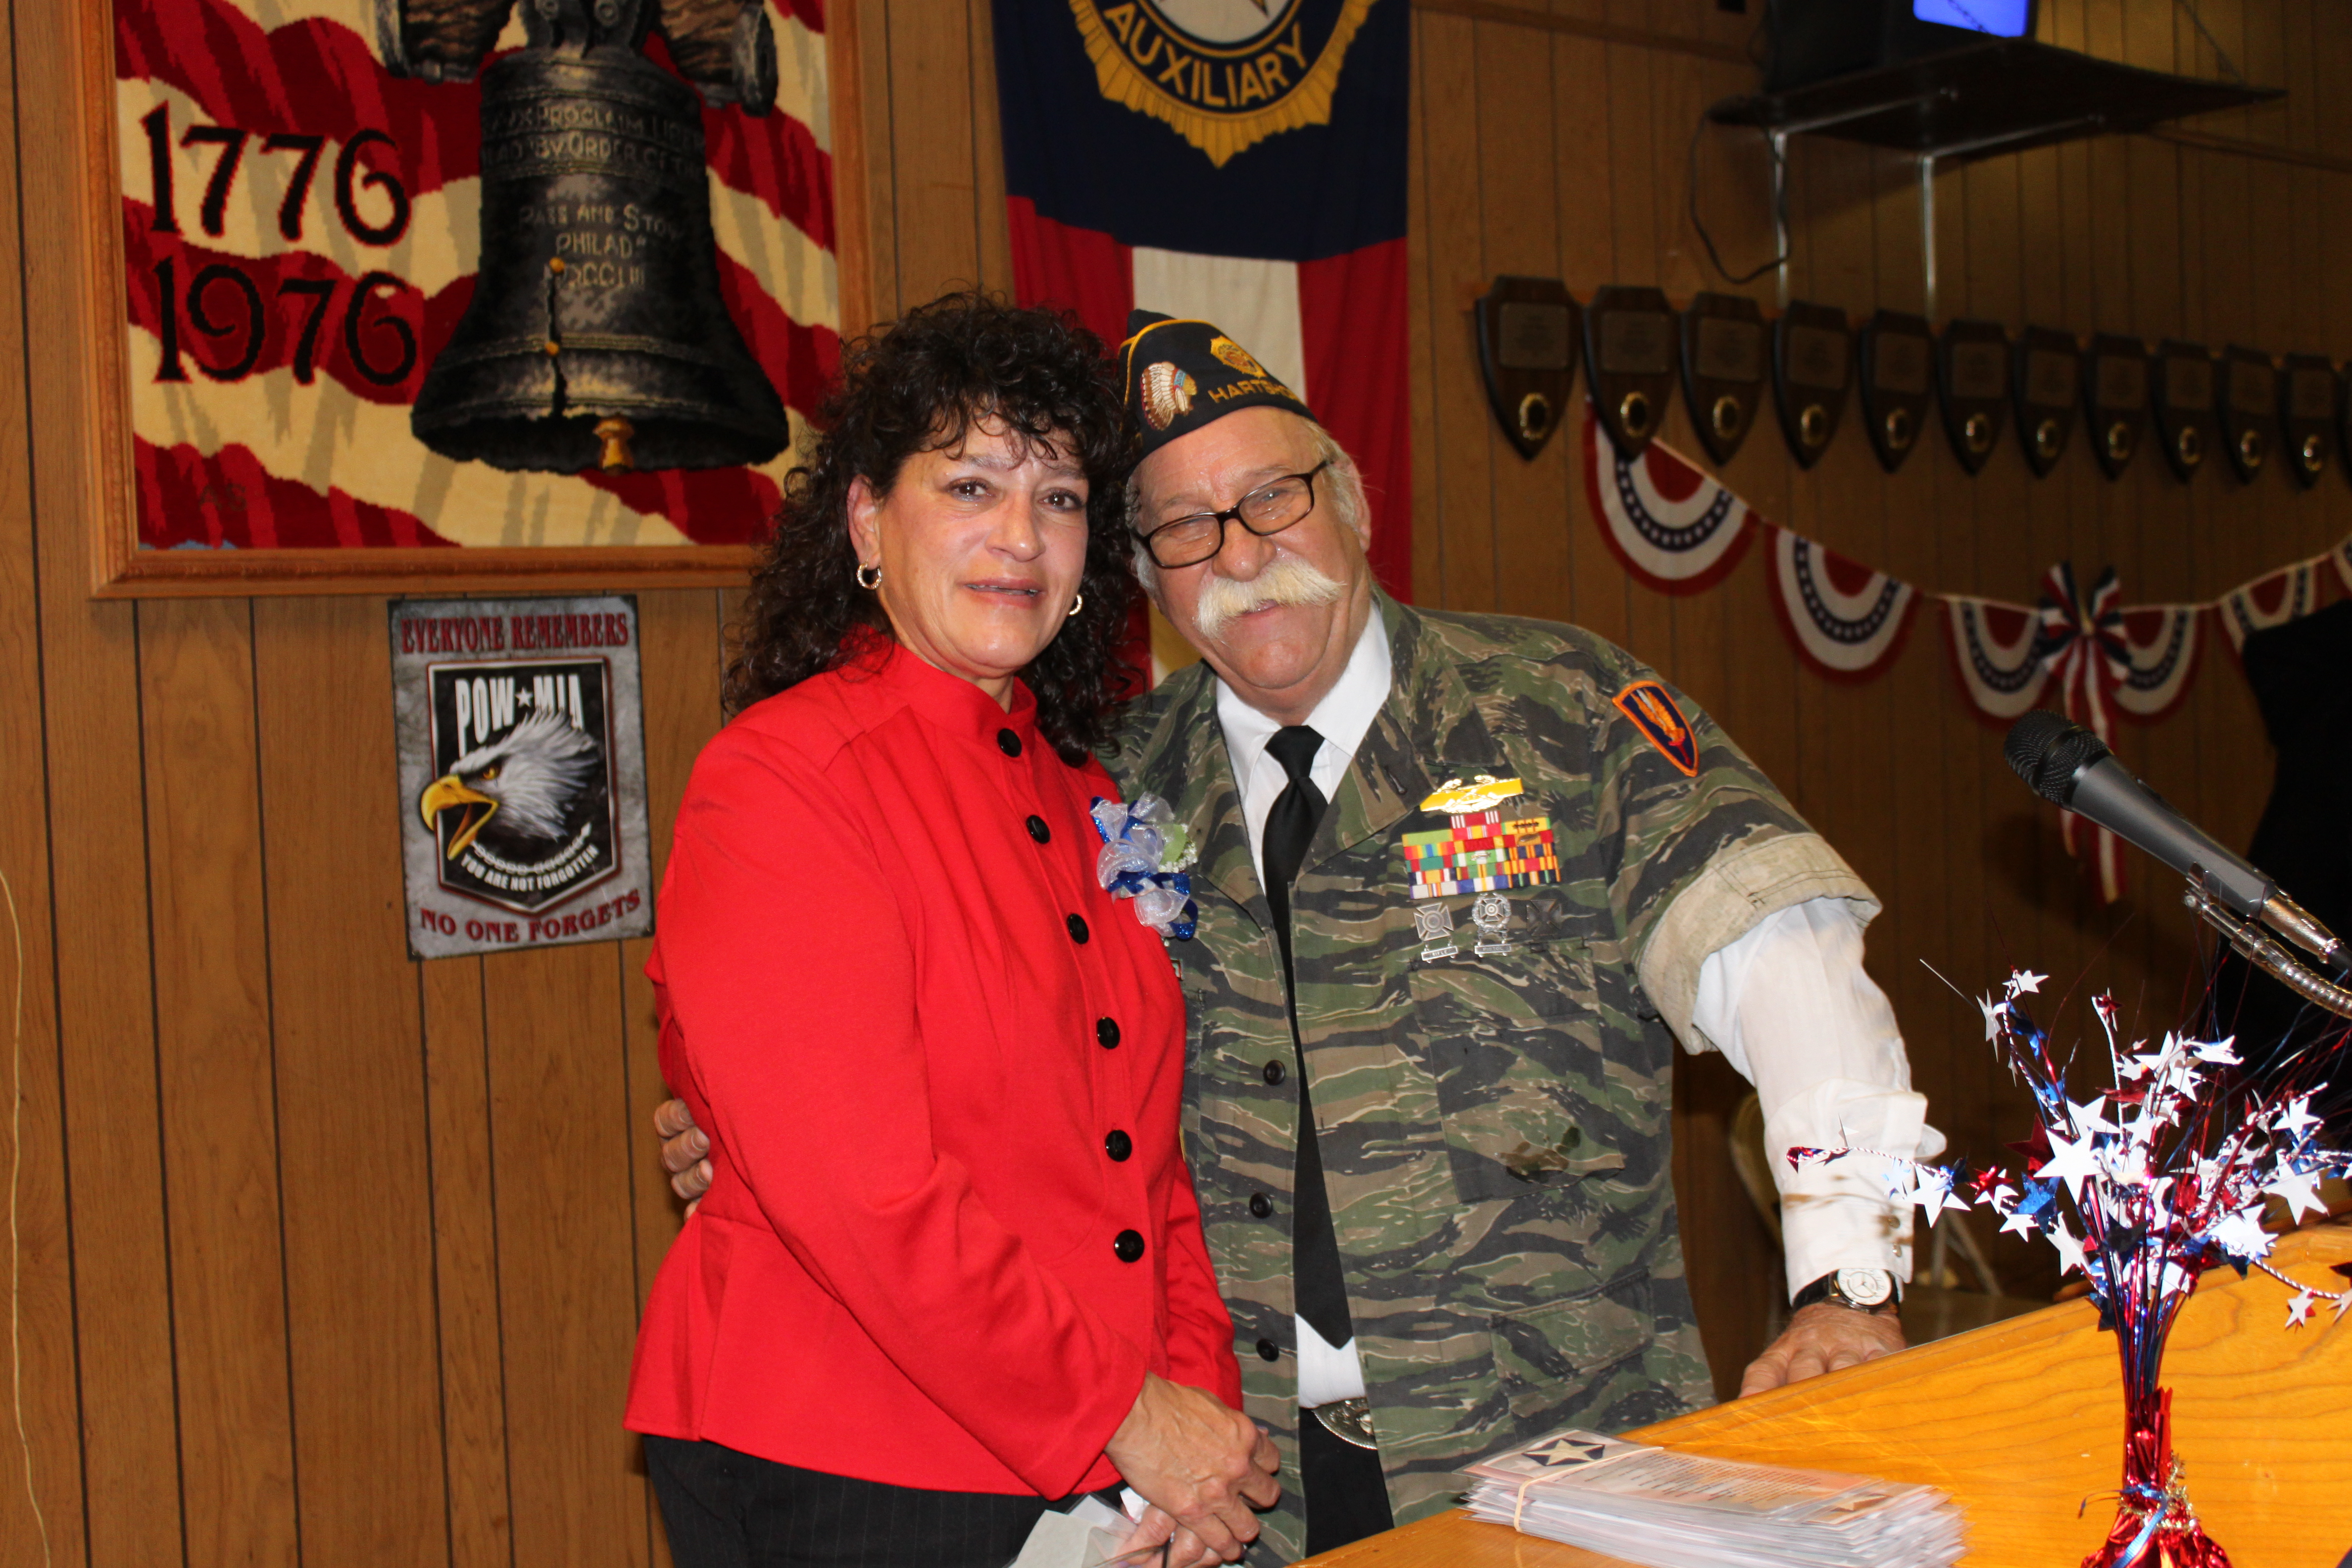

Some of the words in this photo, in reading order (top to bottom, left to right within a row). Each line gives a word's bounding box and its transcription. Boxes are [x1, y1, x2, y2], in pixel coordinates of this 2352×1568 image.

[1103, 2, 1307, 107] AUXILIARY
[140, 99, 412, 247] 1776
[152, 255, 417, 387] 1976
[401, 612, 505, 653] EVERYONE
[510, 613, 629, 649] REMEMBERS
[455, 676, 515, 759] POW
[533, 674, 585, 731] MIA
[461, 852, 484, 880] YOU
[485, 870, 509, 889] ARE
[512, 877, 536, 892] NOT
[537, 843, 599, 890] FORGOTTEN
[419, 907, 457, 936] NO
[465, 918, 519, 942] ONE
[529, 889, 641, 941] FORGETS
